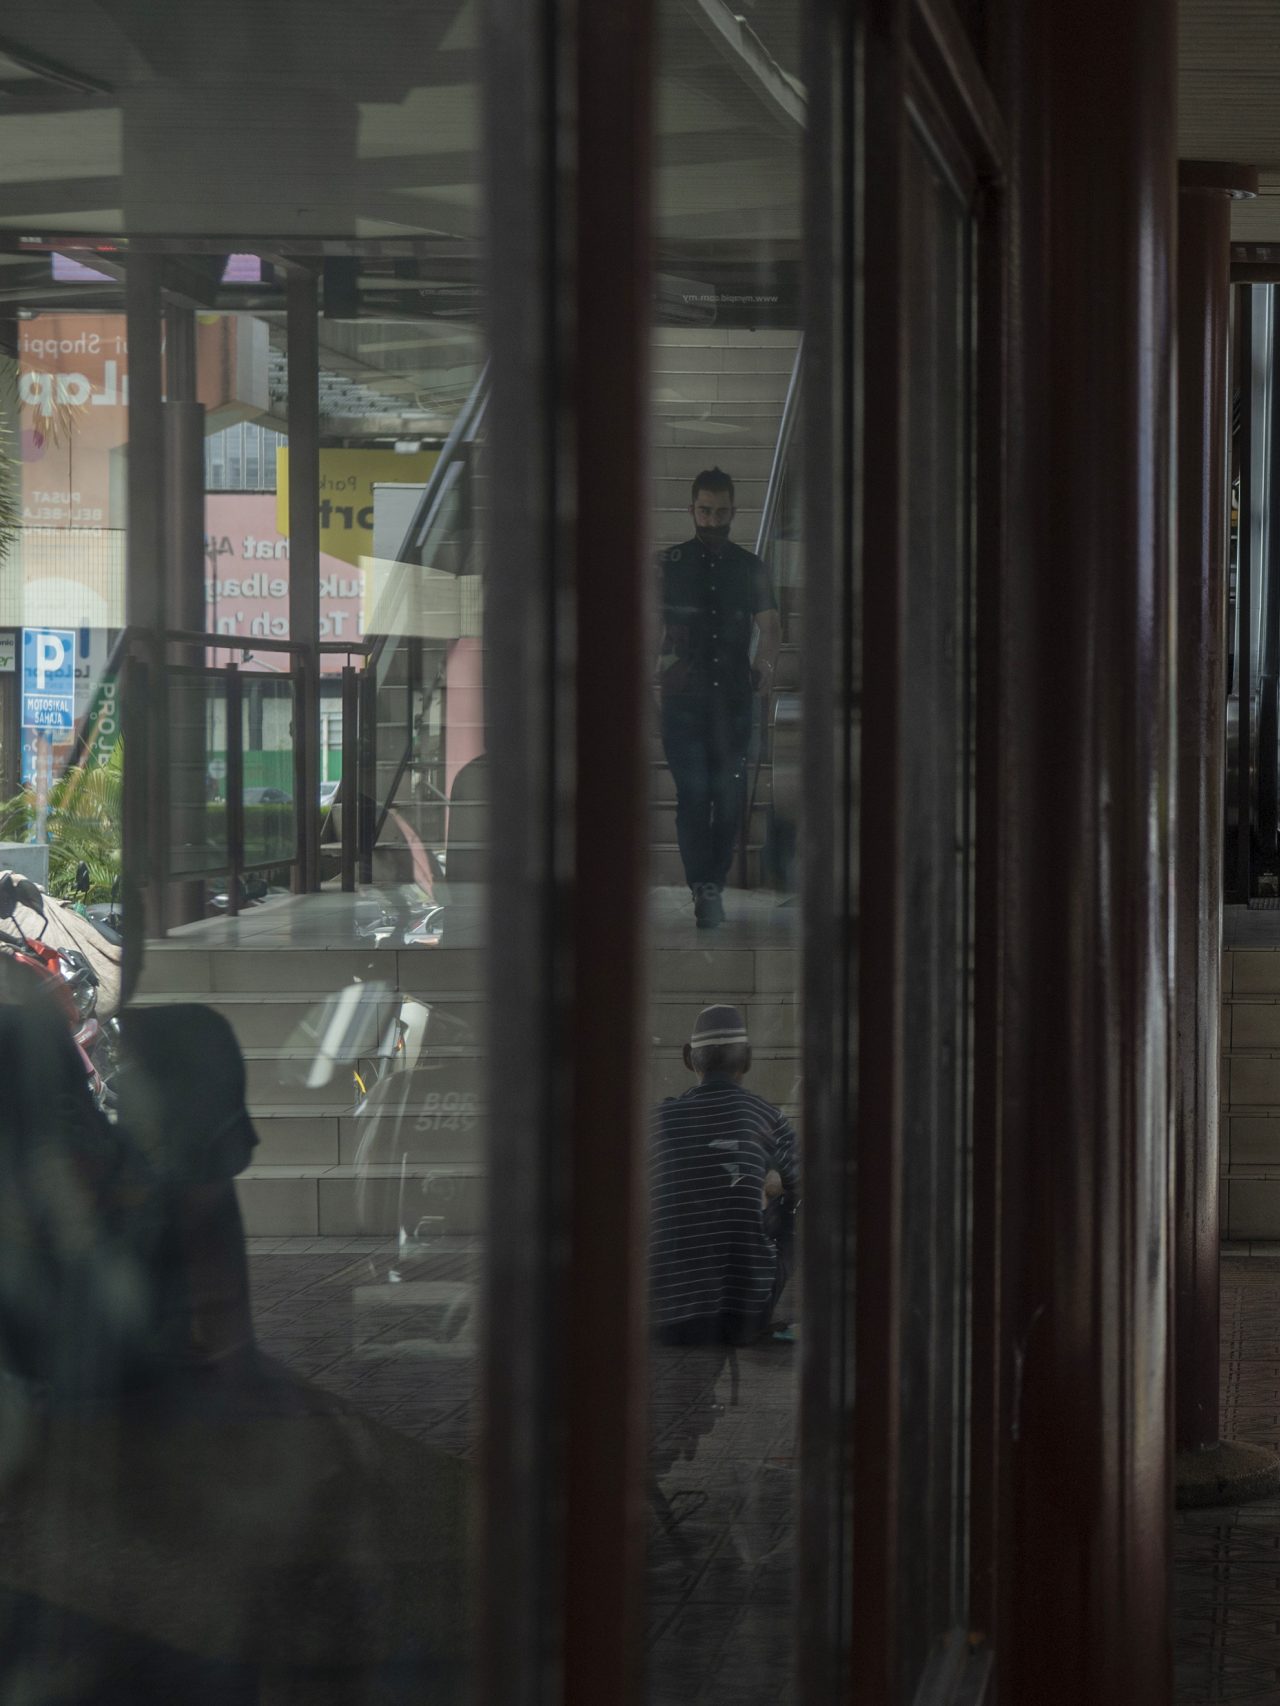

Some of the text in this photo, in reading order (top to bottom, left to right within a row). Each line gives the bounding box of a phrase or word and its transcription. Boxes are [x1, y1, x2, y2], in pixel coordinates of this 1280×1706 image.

[36, 634, 66, 689] P
[27, 698, 69, 712] MOTOSIKAL
[34, 711, 63, 725] SAHAJA
